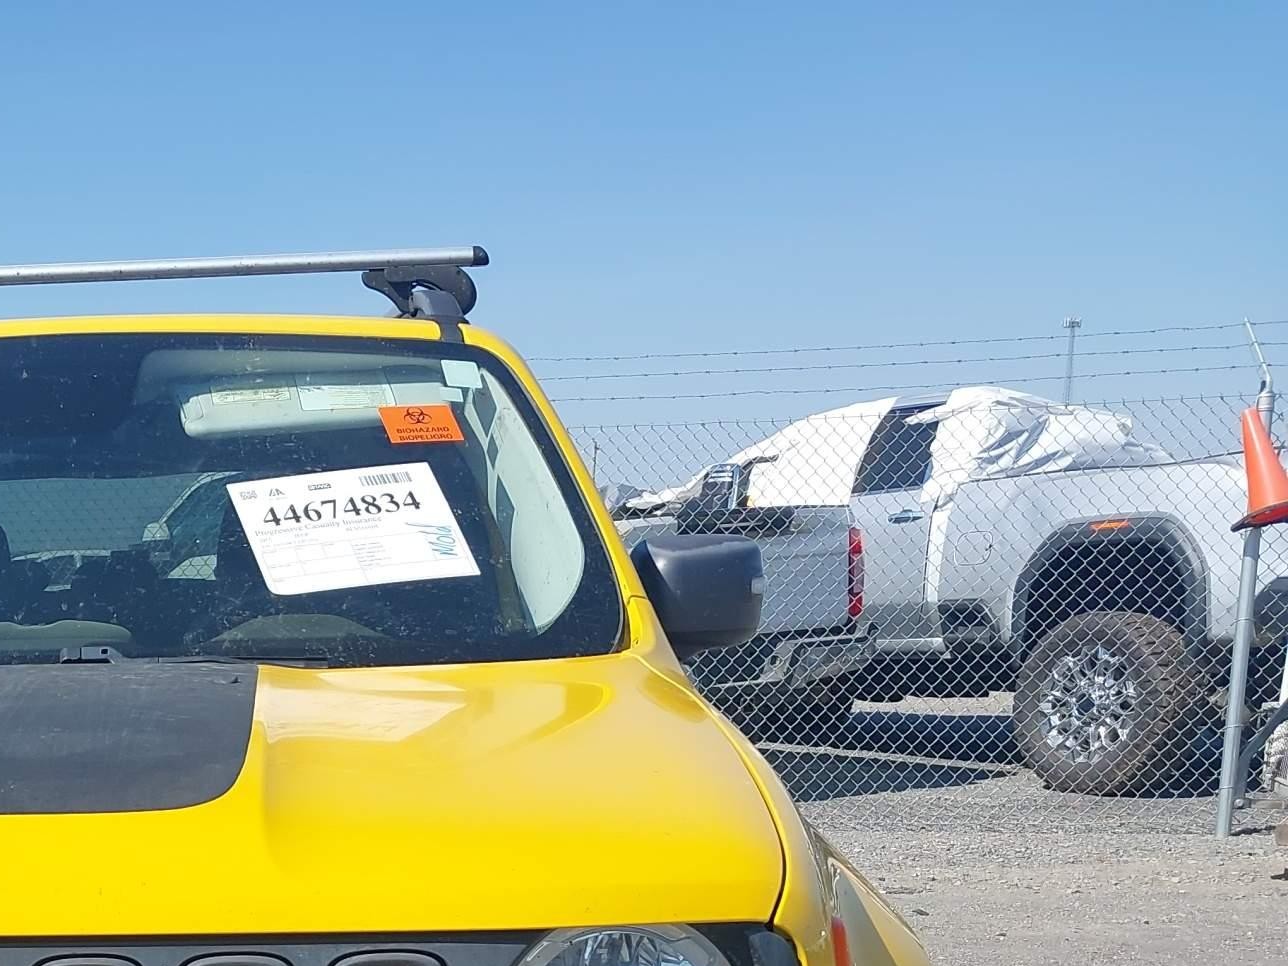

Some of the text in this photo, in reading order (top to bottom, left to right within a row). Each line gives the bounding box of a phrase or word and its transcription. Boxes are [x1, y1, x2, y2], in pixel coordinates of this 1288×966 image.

[396, 426, 450, 434] BIOHAZARD
[398, 433, 454, 441] BIOPELIGRO
[263, 491, 421, 527] 44674834
[255, 525, 304, 537] Progressive
[304, 520, 341, 531] Casualty
[342, 516, 382, 526] Insurance
